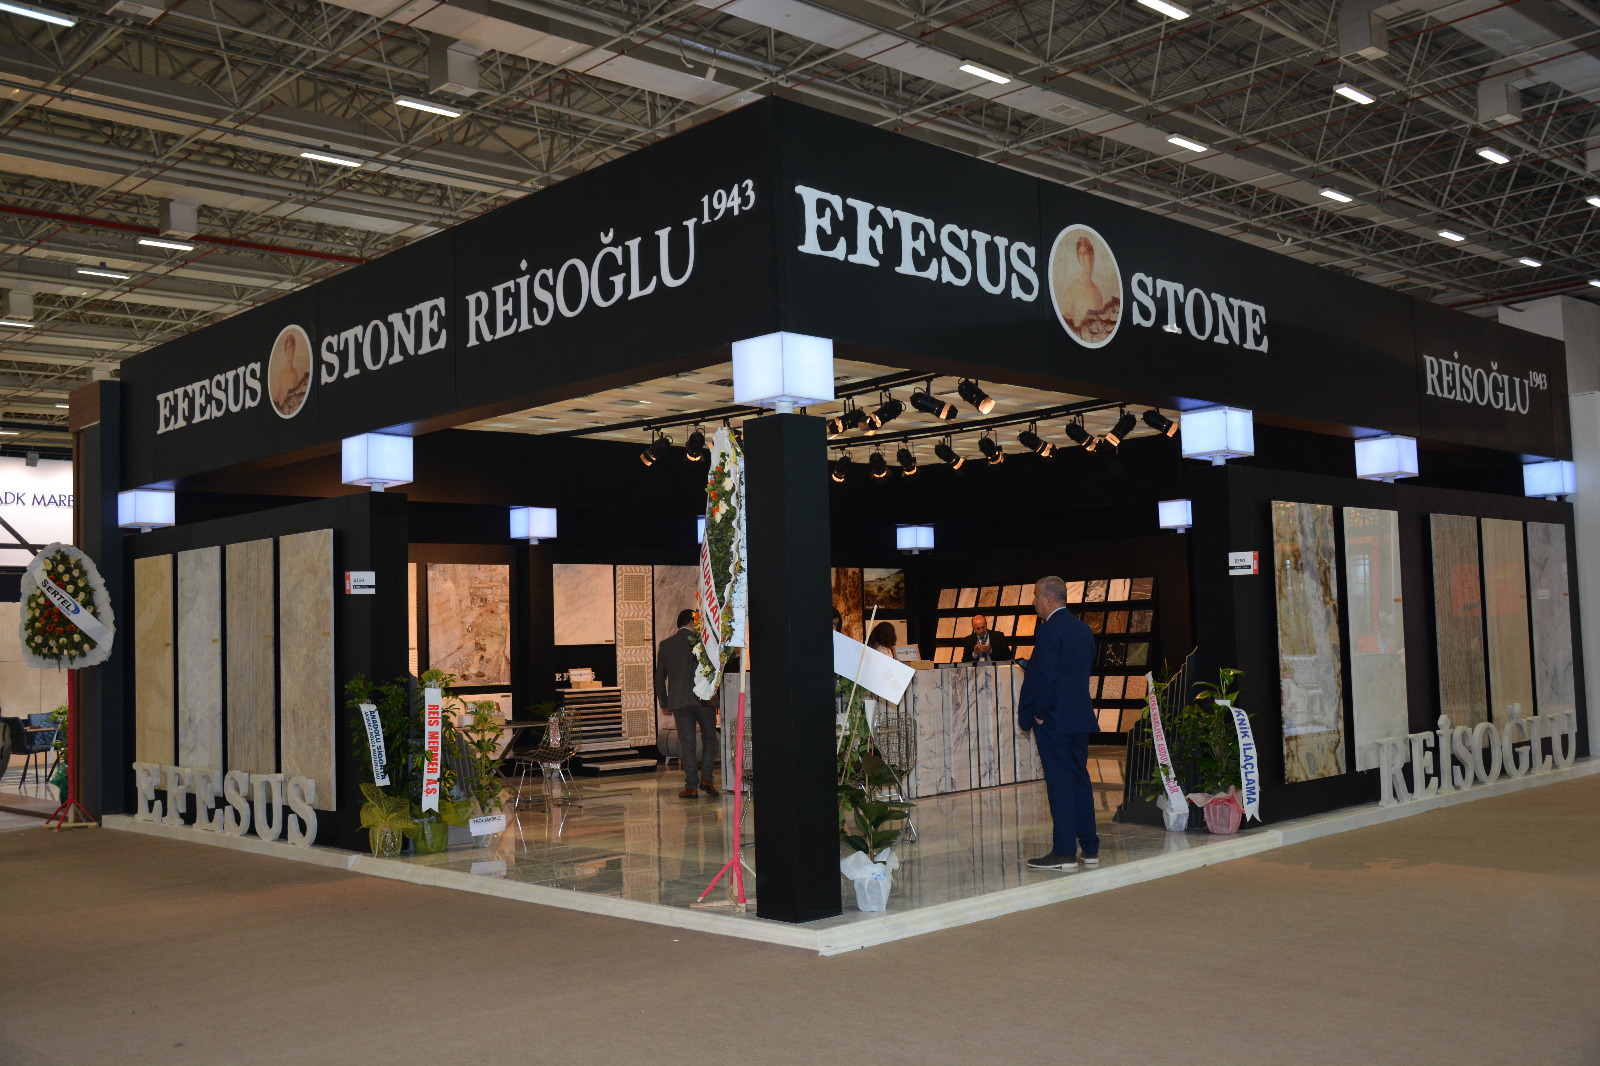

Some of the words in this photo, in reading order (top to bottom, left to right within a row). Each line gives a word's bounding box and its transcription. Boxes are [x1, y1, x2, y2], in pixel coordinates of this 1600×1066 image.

[795, 185, 1039, 302] EFESUS
[1131, 272, 1269, 353] STONE
[157, 362, 262, 434] EFESUS
[320, 297, 447, 386] STONE
[465, 217, 698, 348] REİSOĞLU
[700, 179, 756, 225] 1943
[1423, 351, 1529, 415] REİSOĞLU
[1528, 370, 1548, 390] 1943
[41, 579, 73, 612] SERTEL
[369, 710, 382, 743] ANADOLU
[428, 704, 441, 727] REİS
[427, 731, 440, 774] MERMER
[1240, 743, 1257, 805] İLAÇLAMA
[1375, 703, 1577, 807] REİSOĞLU
[132, 762, 318, 848] EFESUS
